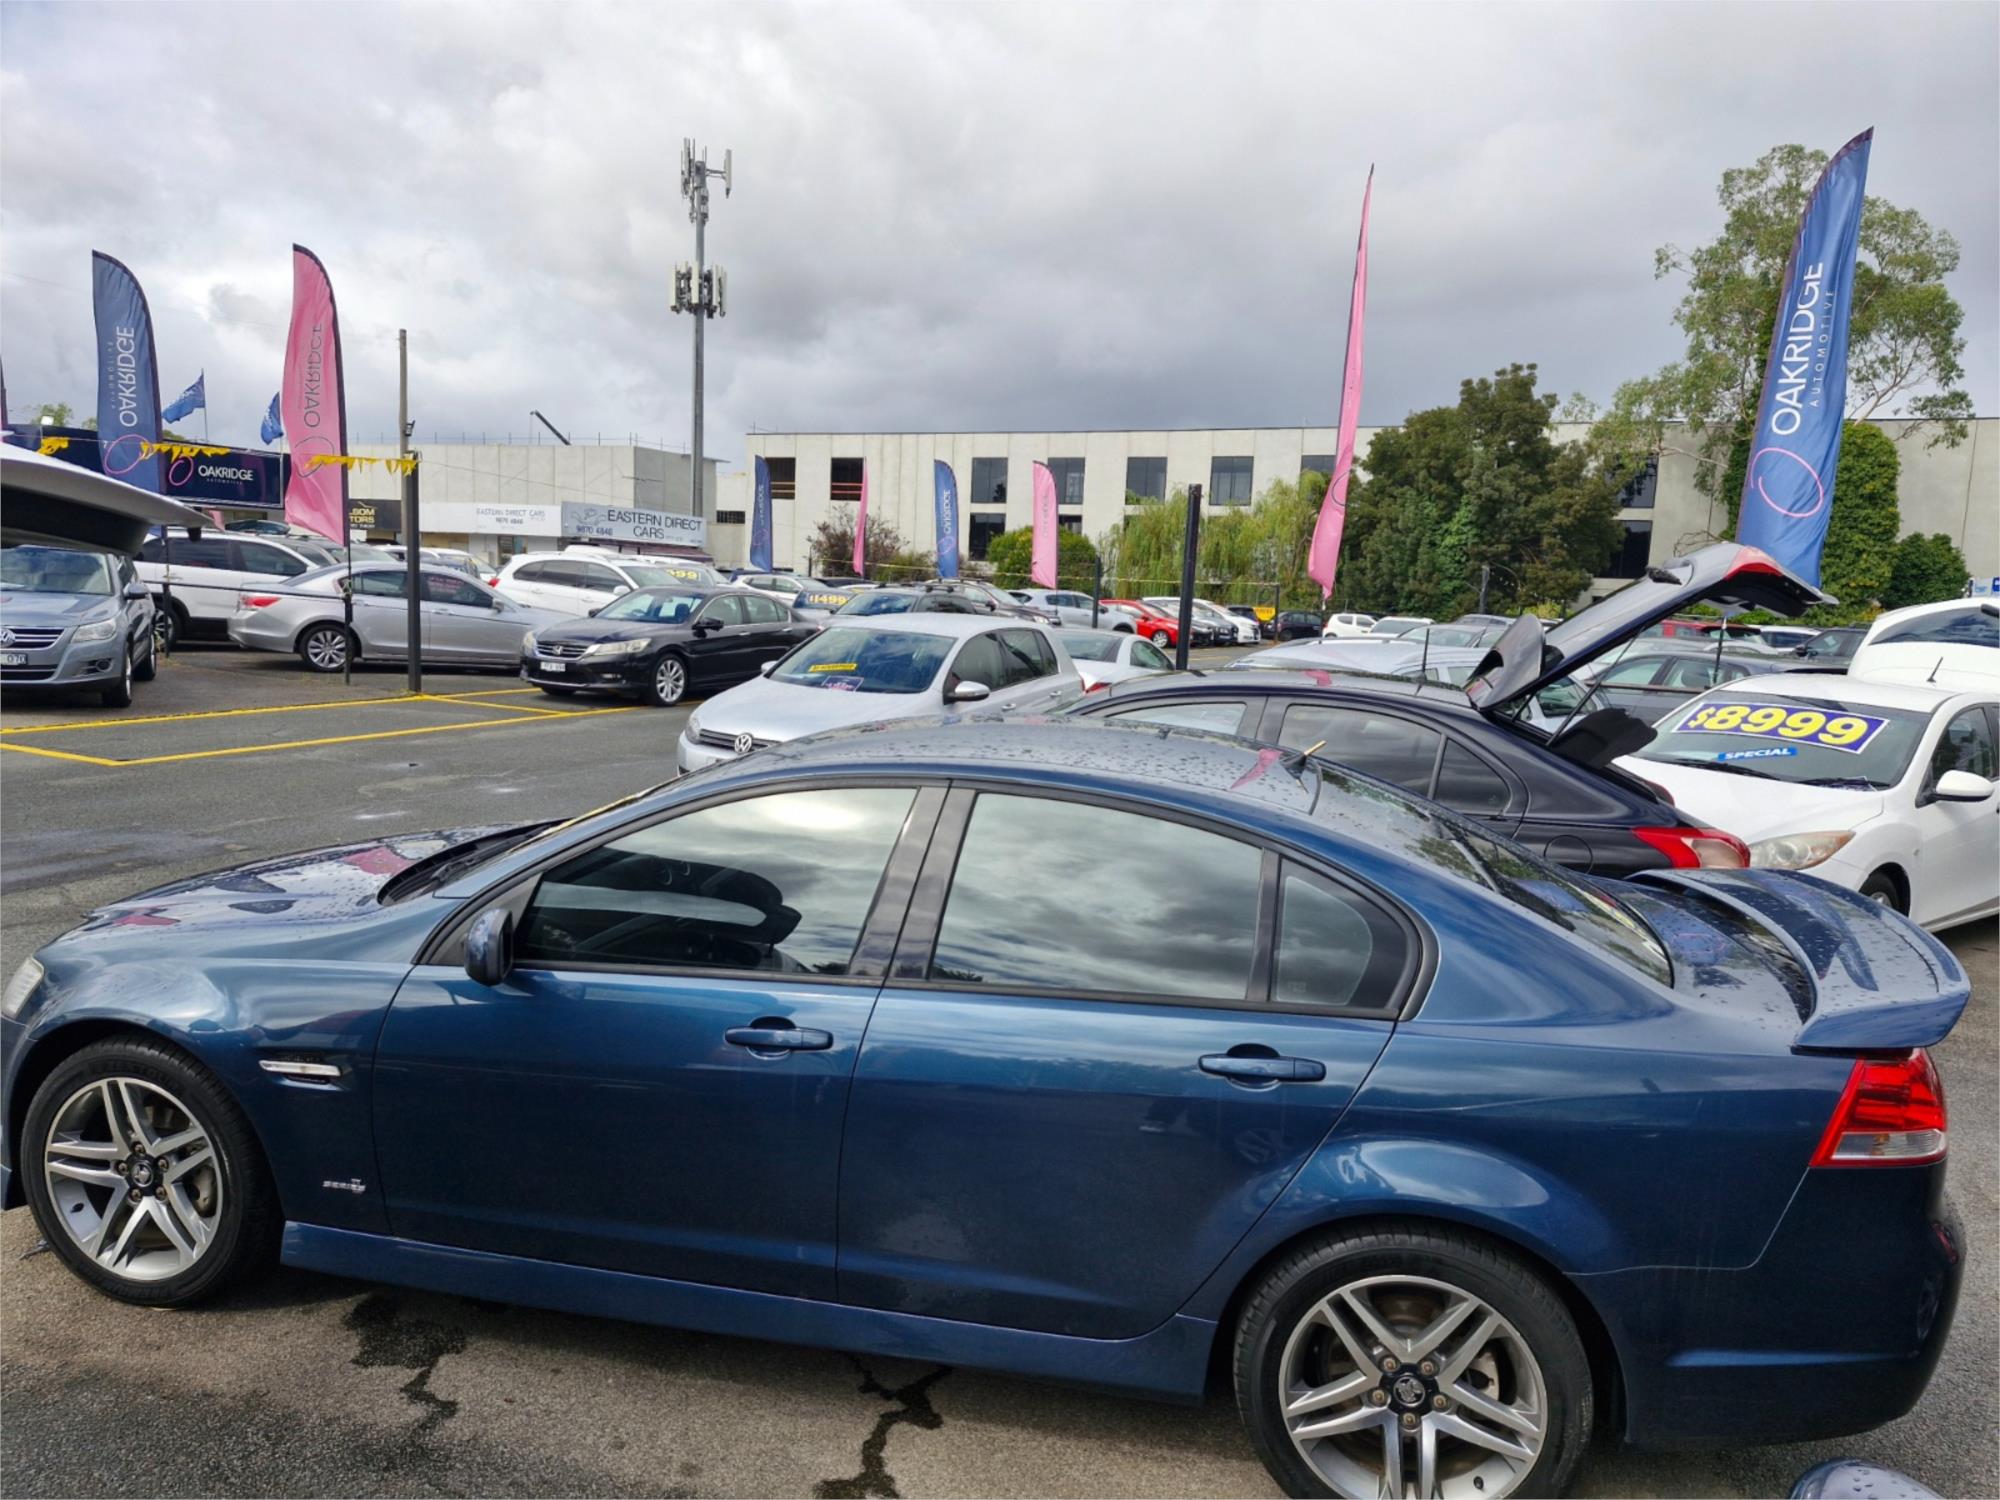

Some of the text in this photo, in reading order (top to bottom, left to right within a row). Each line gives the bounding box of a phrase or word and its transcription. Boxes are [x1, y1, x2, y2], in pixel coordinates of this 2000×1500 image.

[1772, 262, 1824, 436] OAKRIDGE
[1809, 290, 1836, 407] AUTOMOTIVE
[198, 465, 254, 480] OAKRIDGE
[607, 509, 702, 531] EASTERN DIRECT
[633, 525, 665, 539] CARS
[1687, 705, 1868, 746] $8999
[1725, 748, 1791, 760] SPECIAL
